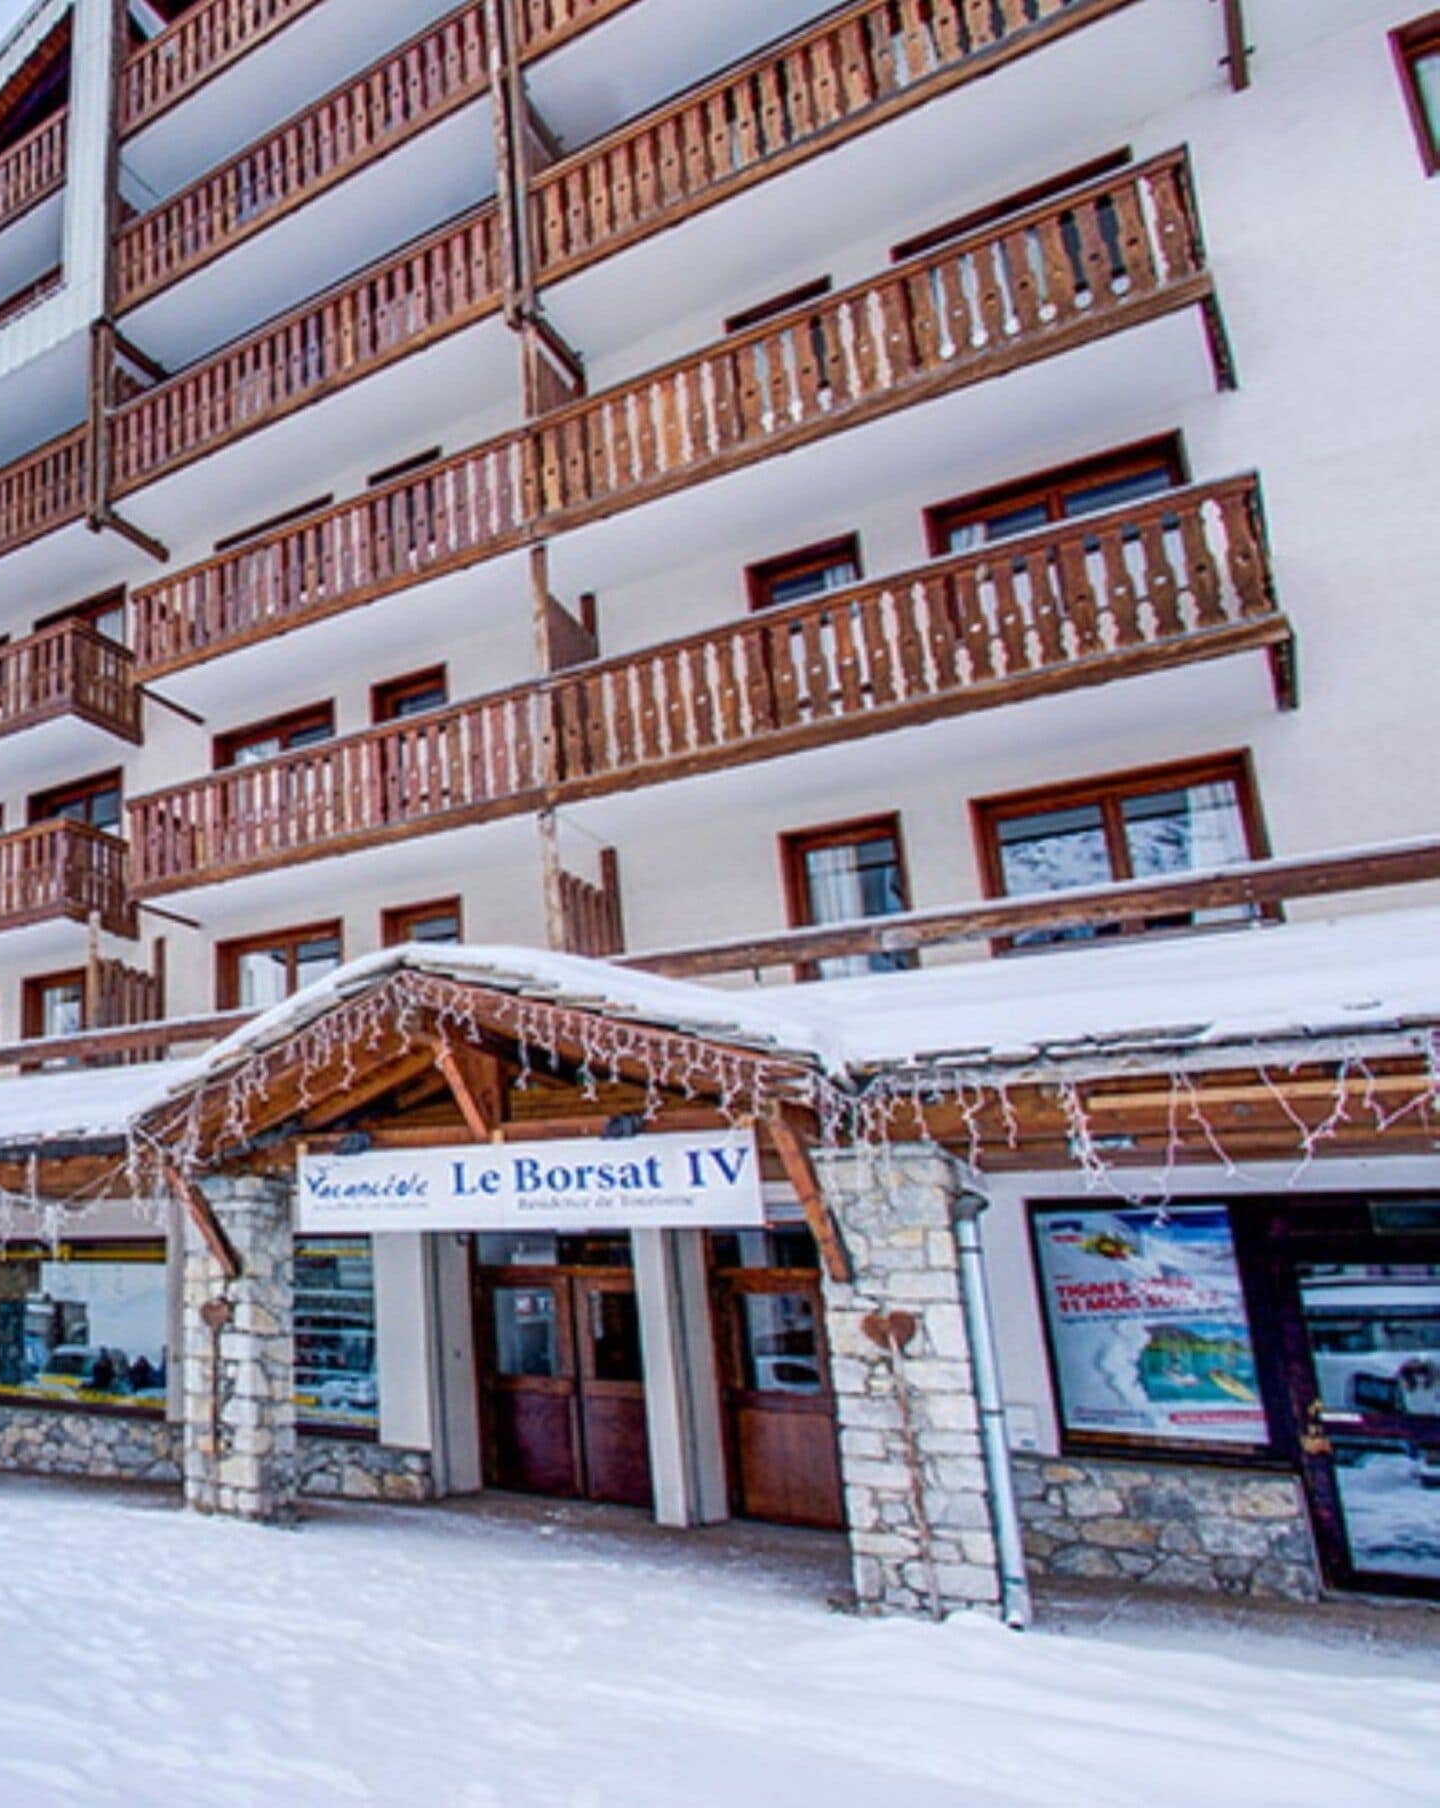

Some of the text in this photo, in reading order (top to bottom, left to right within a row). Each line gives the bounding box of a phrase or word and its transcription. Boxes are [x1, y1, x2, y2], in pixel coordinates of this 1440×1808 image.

[449, 1147, 748, 1195] Le Borsat IV
